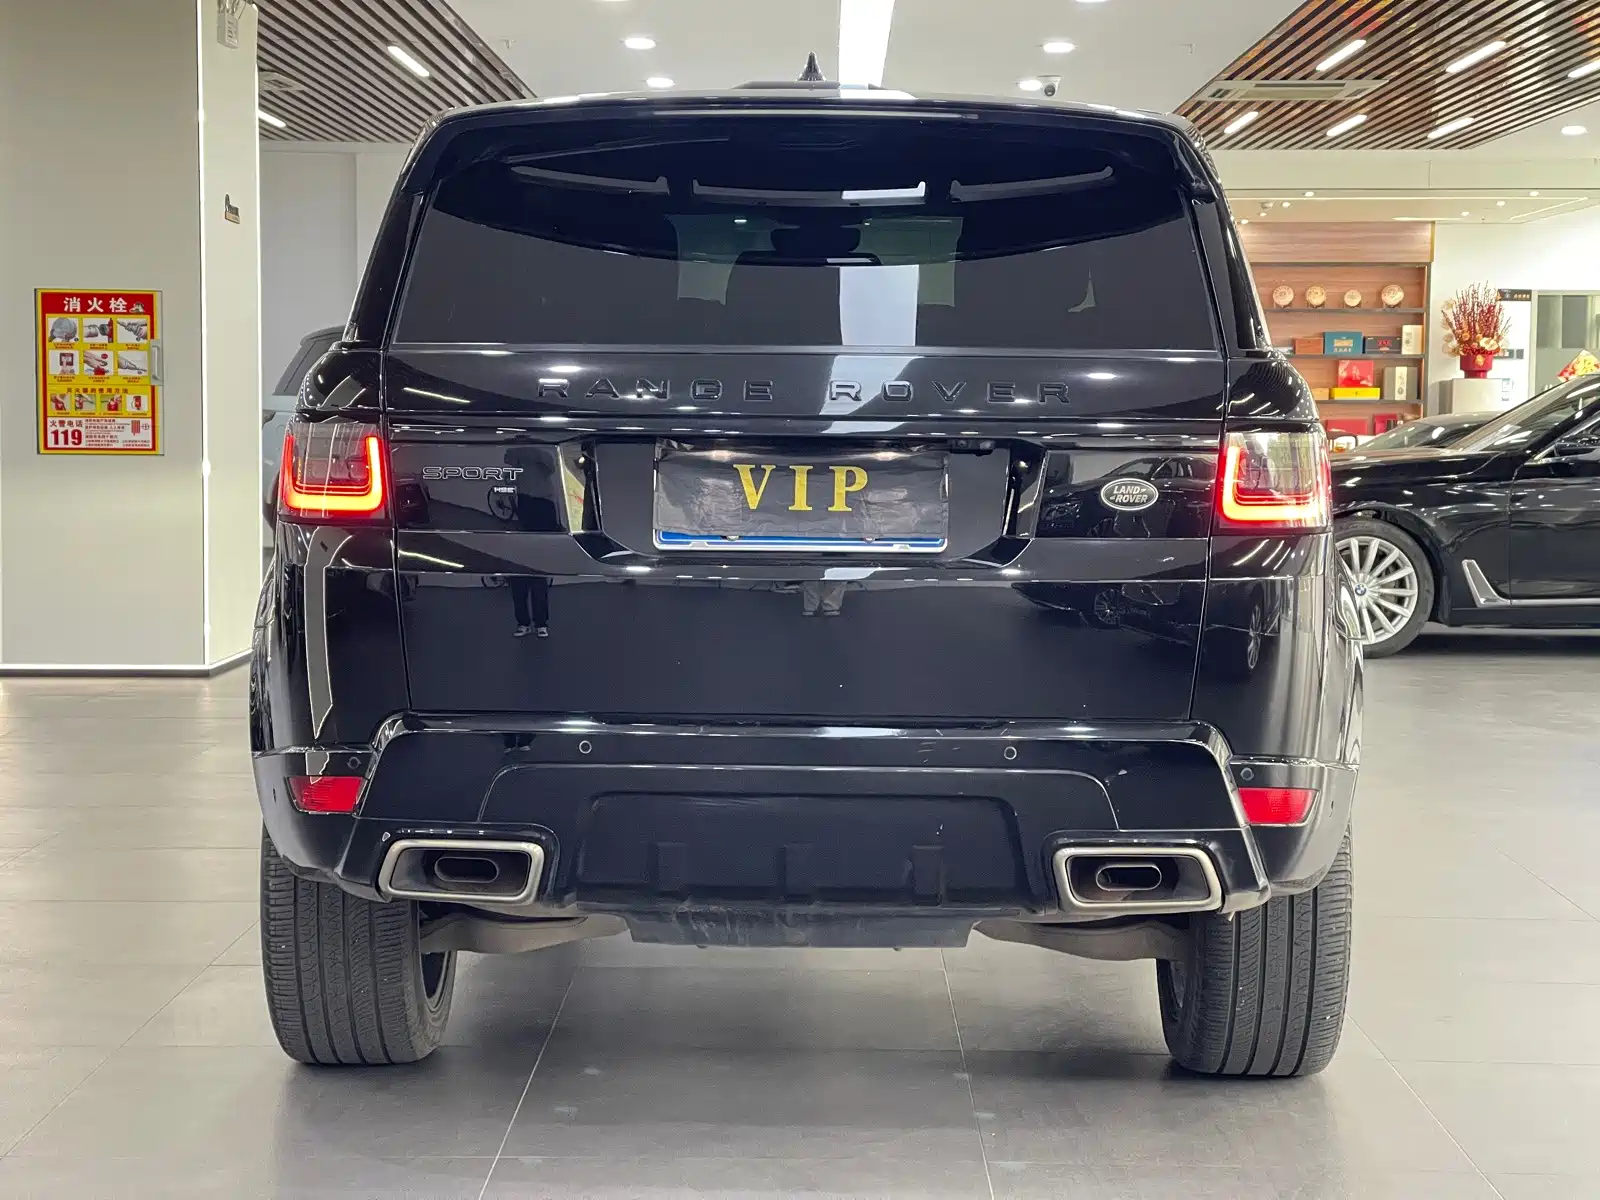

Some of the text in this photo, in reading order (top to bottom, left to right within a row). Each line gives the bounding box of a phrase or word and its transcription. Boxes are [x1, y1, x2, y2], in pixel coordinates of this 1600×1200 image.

[63, 296, 128, 313] 消火栓
[536, 376, 1071, 404] RANGE ROVER
[49, 419, 83, 428] 火警电话
[50, 428, 83, 446] 119
[422, 466, 524, 481] SPORT
[732, 463, 869, 513] VIP
[1113, 485, 1141, 495] LAND
[1115, 494, 1148, 503] ROVER
